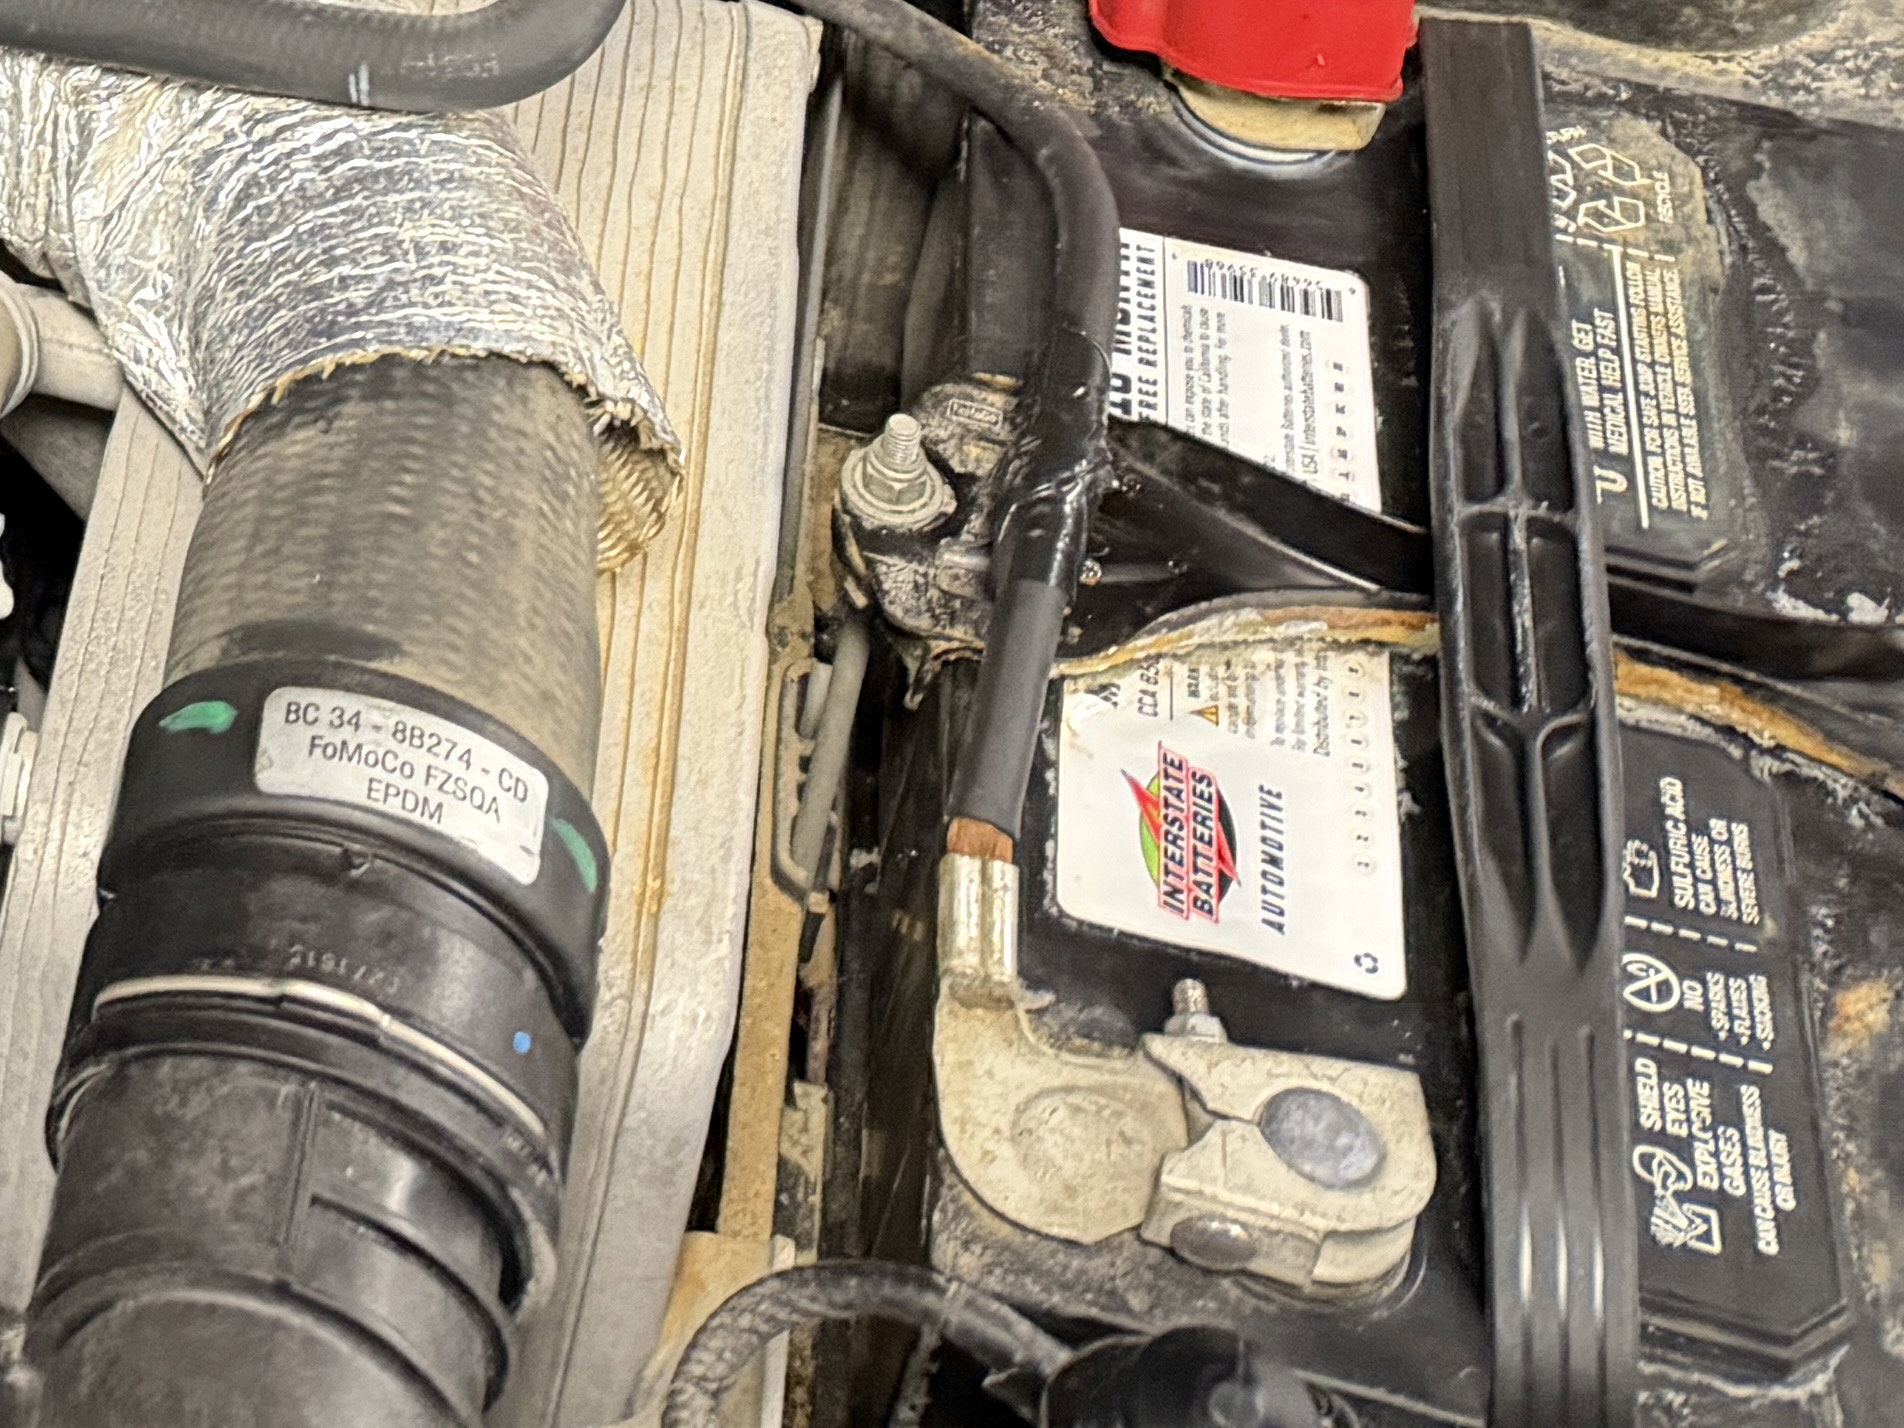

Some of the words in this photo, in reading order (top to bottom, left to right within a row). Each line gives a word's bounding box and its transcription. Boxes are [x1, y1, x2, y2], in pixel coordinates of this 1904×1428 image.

[1136, 243, 1159, 369] REPLACEMENT
[1595, 307, 1617, 347] FAST
[1598, 347, 1621, 389] HELP
[1137, 375, 1159, 422] FREE
[1602, 390, 1628, 456] MEDICAL
[1137, 694, 1159, 718] CCA
[283, 701, 321, 727] BC
[328, 705, 362, 733] 34
[391, 719, 474, 772] 8B274
[497, 767, 530, 804] CD
[307, 734, 416, 780] FoMoCo
[423, 763, 503, 824] FZSQA
[366, 776, 445, 826] EPDM
[1659, 775, 1687, 821] ACID
[1161, 751, 1186, 915] INTERSTATE
[1191, 769, 1215, 916] BATTERIES
[1258, 783, 1286, 936] AUTOMOTIVE
[1691, 832, 1714, 881] CAUSE
[1664, 818, 1696, 912] SULFURIC
[1696, 881, 1718, 917] CAN
[1736, 870, 1761, 926] SEVERE
[1681, 979, 1705, 1013] NO
[1634, 1056, 1663, 1133] SHIELD
[1661, 1080, 1690, 1139] EYES
[1685, 1077, 1721, 1192] EXPLOSIVE
[1717, 1124, 1747, 1198] GASES
[1749, 1167, 1776, 1221] CAUSE
[1754, 1217, 1780, 1257] CAN
